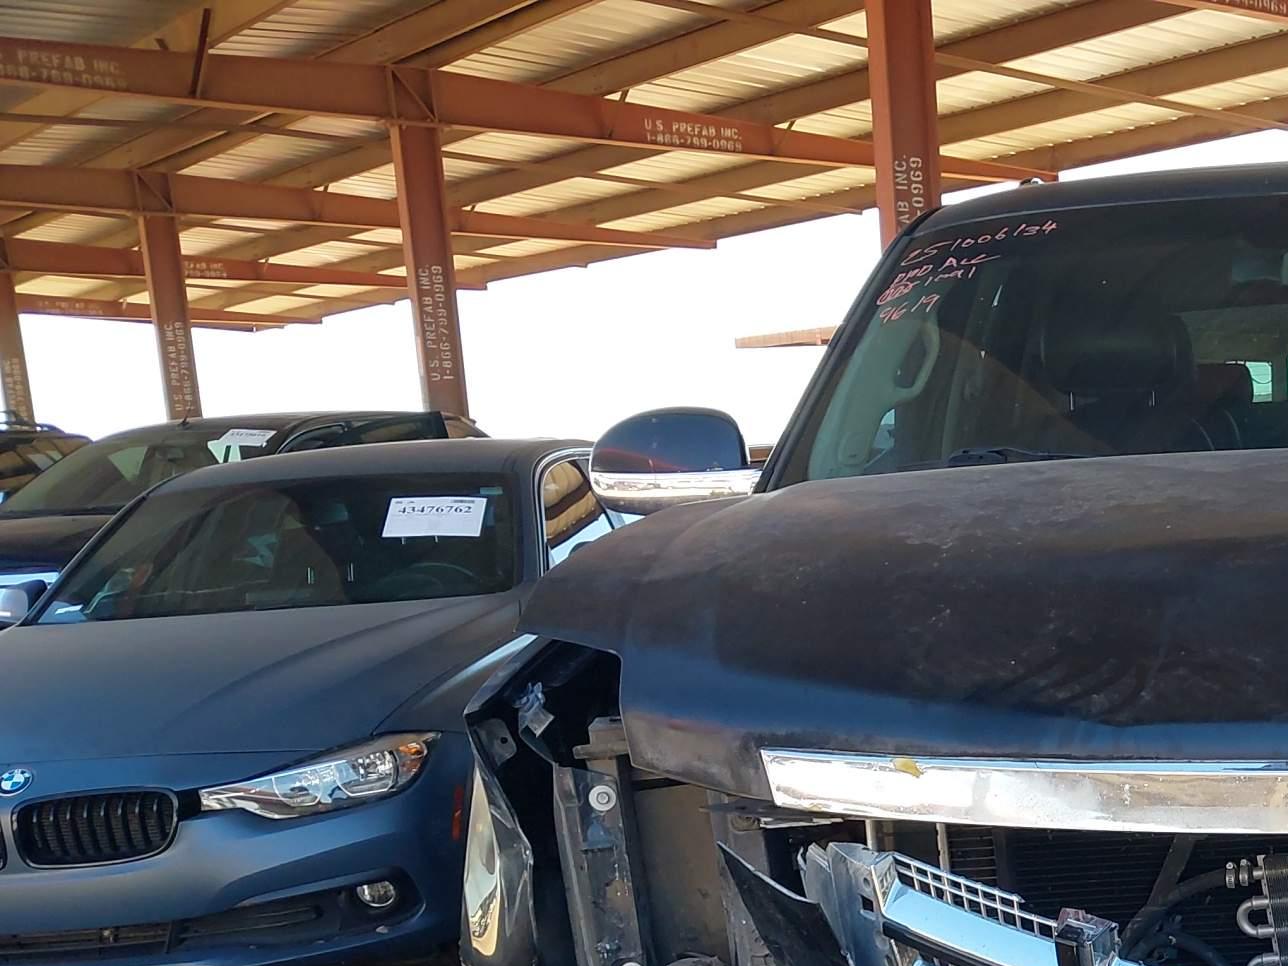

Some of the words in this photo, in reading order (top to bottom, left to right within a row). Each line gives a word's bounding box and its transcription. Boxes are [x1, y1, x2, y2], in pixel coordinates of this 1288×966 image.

[646, 132, 743, 152] 1-866-799-0969
[672, 121, 716, 138] PREFAB
[720, 127, 742, 140] INC.
[894, 154, 909, 190] INC.
[418, 264, 432, 290] INC.
[422, 296, 438, 349] PREFAB
[431, 265, 455, 380] 1-866-799-0969
[397, 505, 473, 514] 43476762
